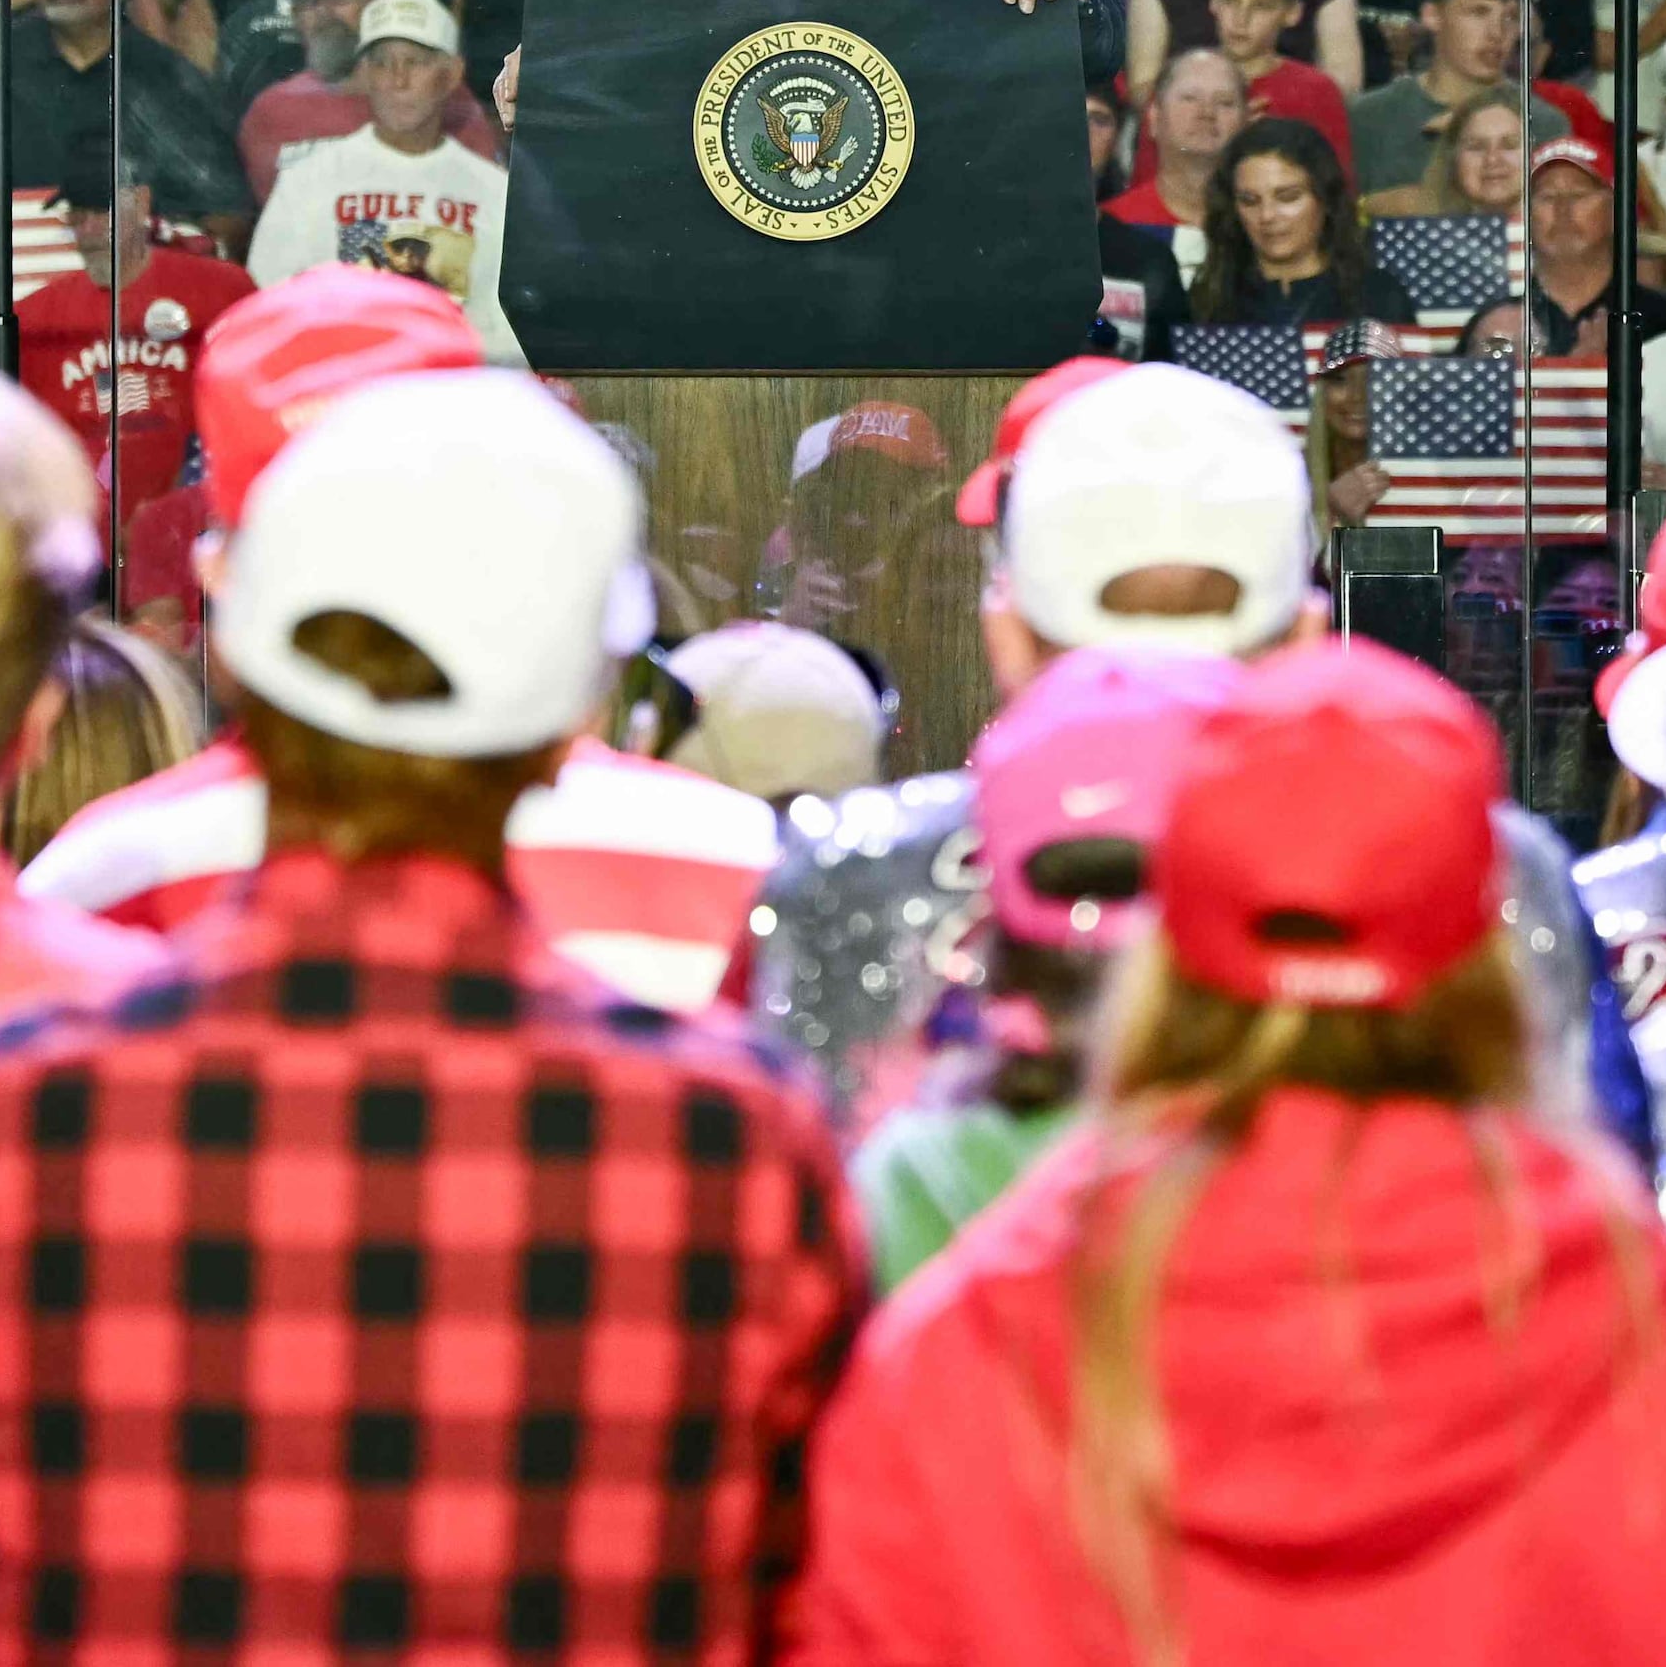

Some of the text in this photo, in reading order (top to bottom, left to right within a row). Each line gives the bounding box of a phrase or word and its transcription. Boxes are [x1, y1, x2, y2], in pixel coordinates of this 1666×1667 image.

[701, 30, 907, 231] SEAL OF THE PRESIDENT OF THE UNITED STATES
[336, 193, 424, 226] GULF
